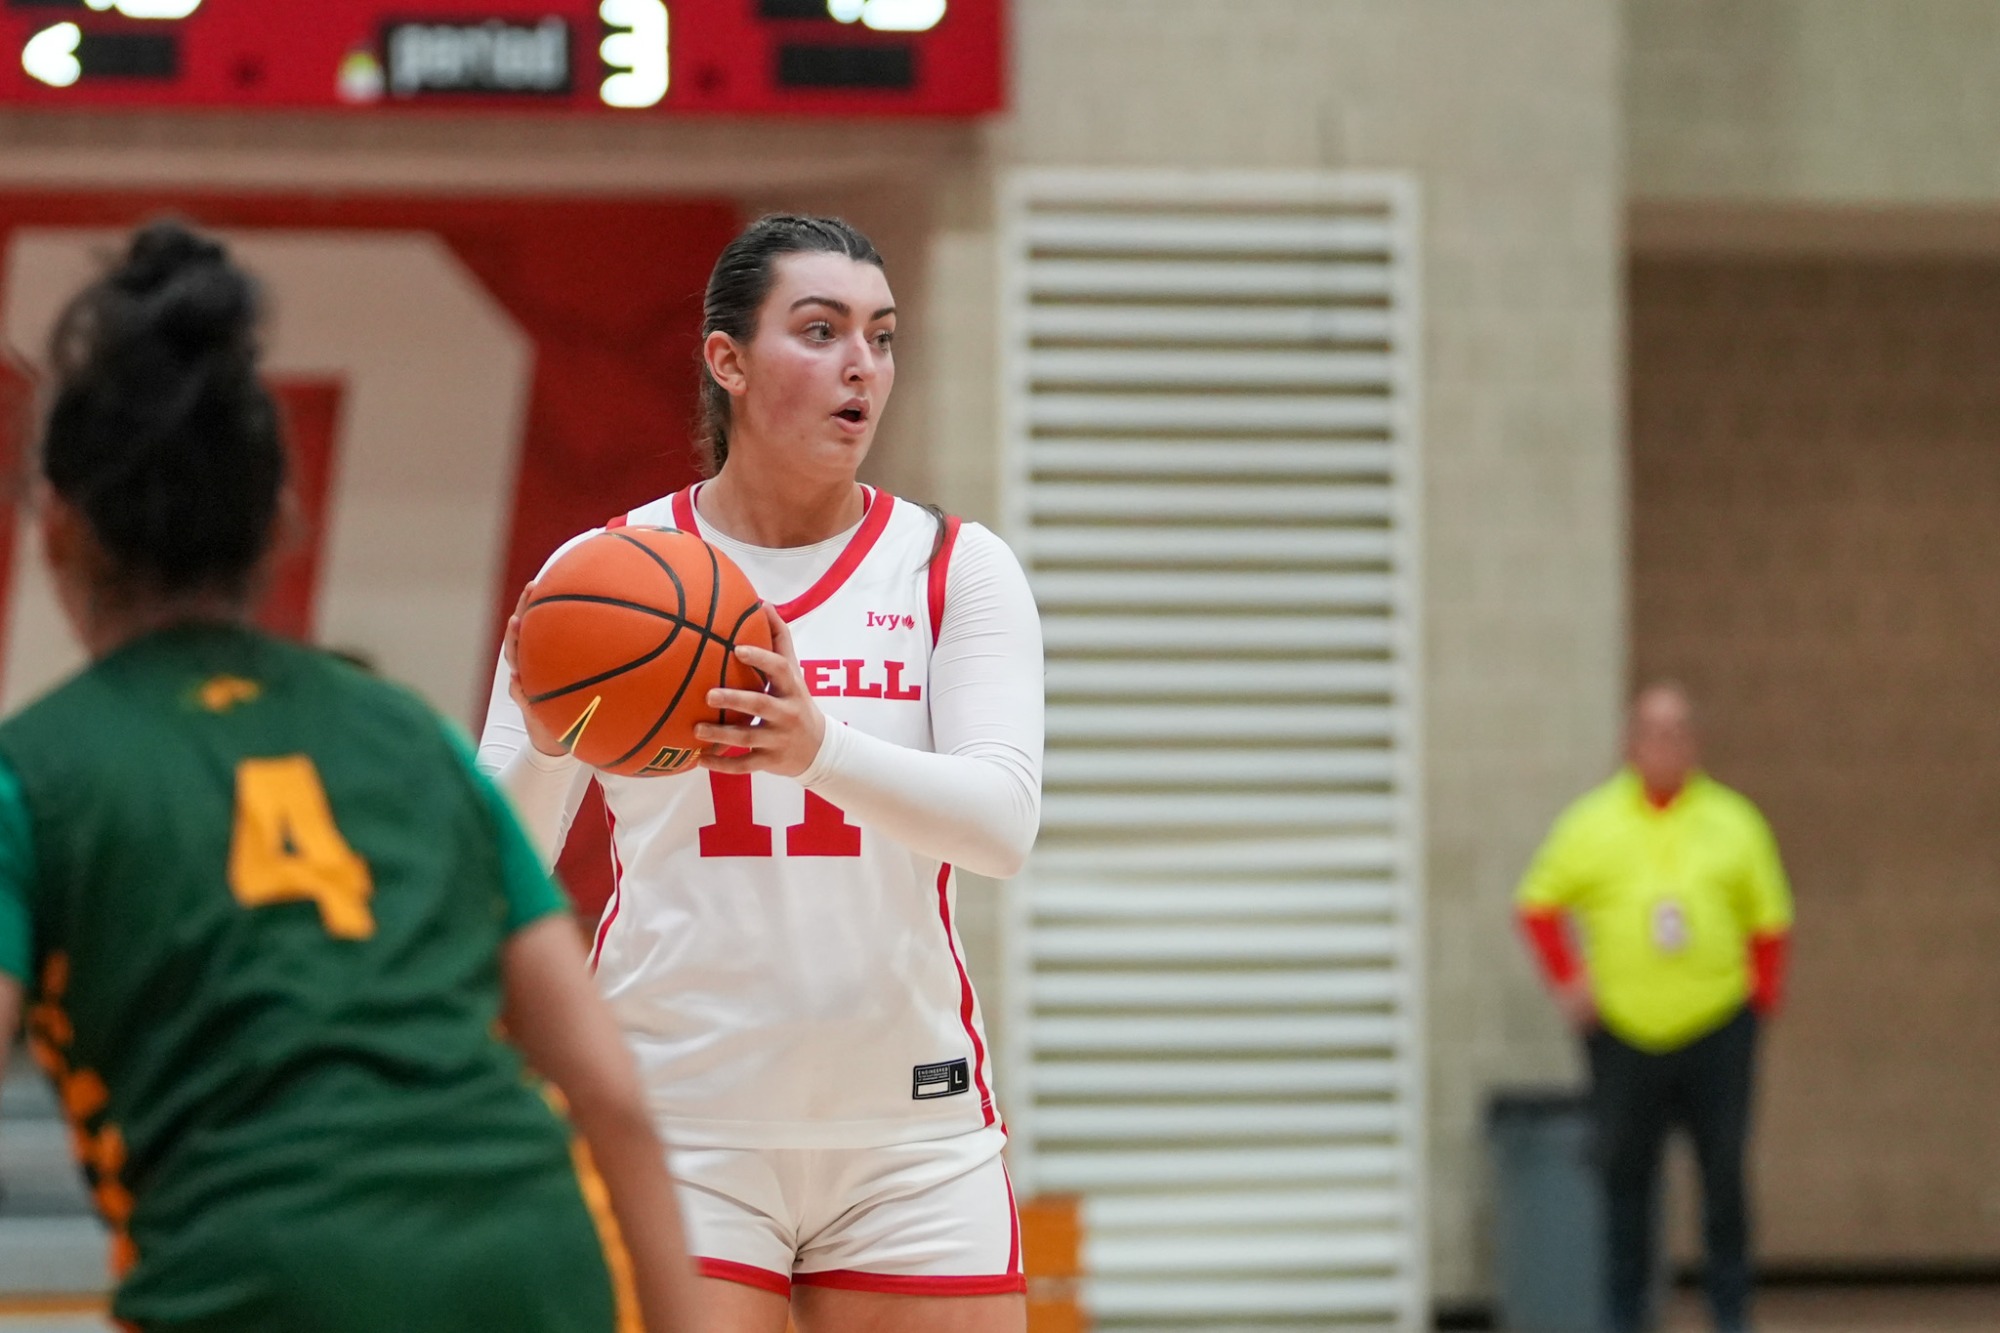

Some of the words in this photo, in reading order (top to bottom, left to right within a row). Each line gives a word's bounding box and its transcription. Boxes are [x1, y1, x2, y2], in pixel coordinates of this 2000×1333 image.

[388, 16, 568, 97] period
[599, 0, 669, 108] 3
[866, 611, 901, 631] Ivy
[799, 658, 922, 702] ELL
[226, 752, 377, 940] 4
[955, 1070, 963, 1084] L
